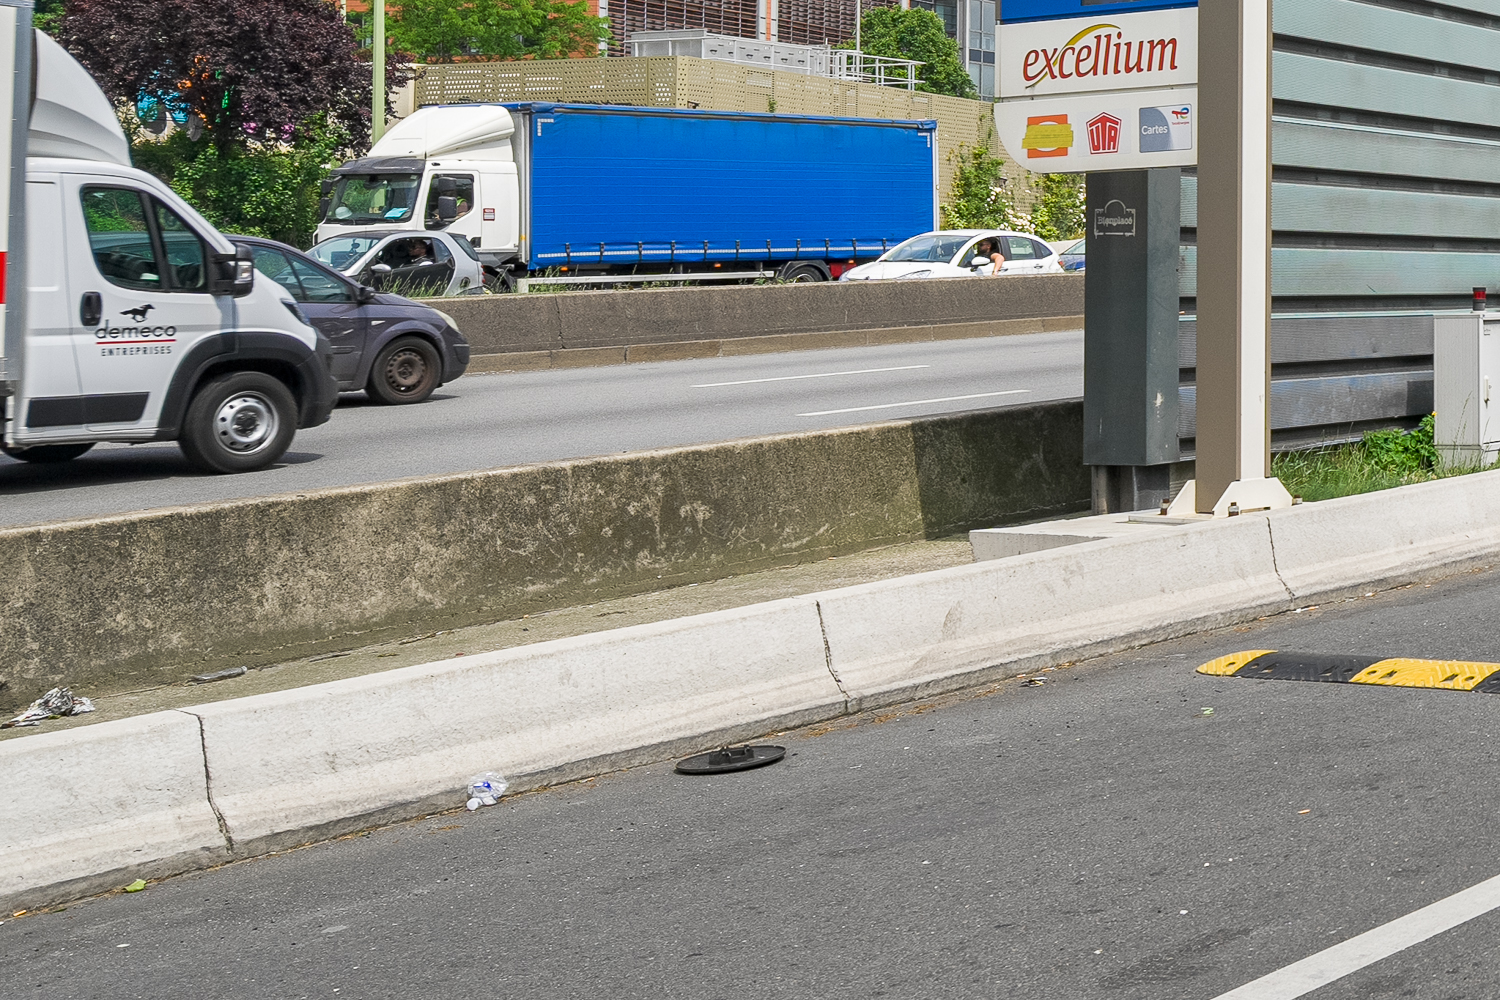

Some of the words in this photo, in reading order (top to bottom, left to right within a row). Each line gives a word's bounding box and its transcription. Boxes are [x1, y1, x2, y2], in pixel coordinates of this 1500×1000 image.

[1023, 30, 1178, 83] excellium
[1088, 114, 1120, 152] UTA
[1141, 125, 1168, 135] Cartes
[95, 319, 177, 339] demeco
[101, 345, 172, 356] ENTREPRISES
